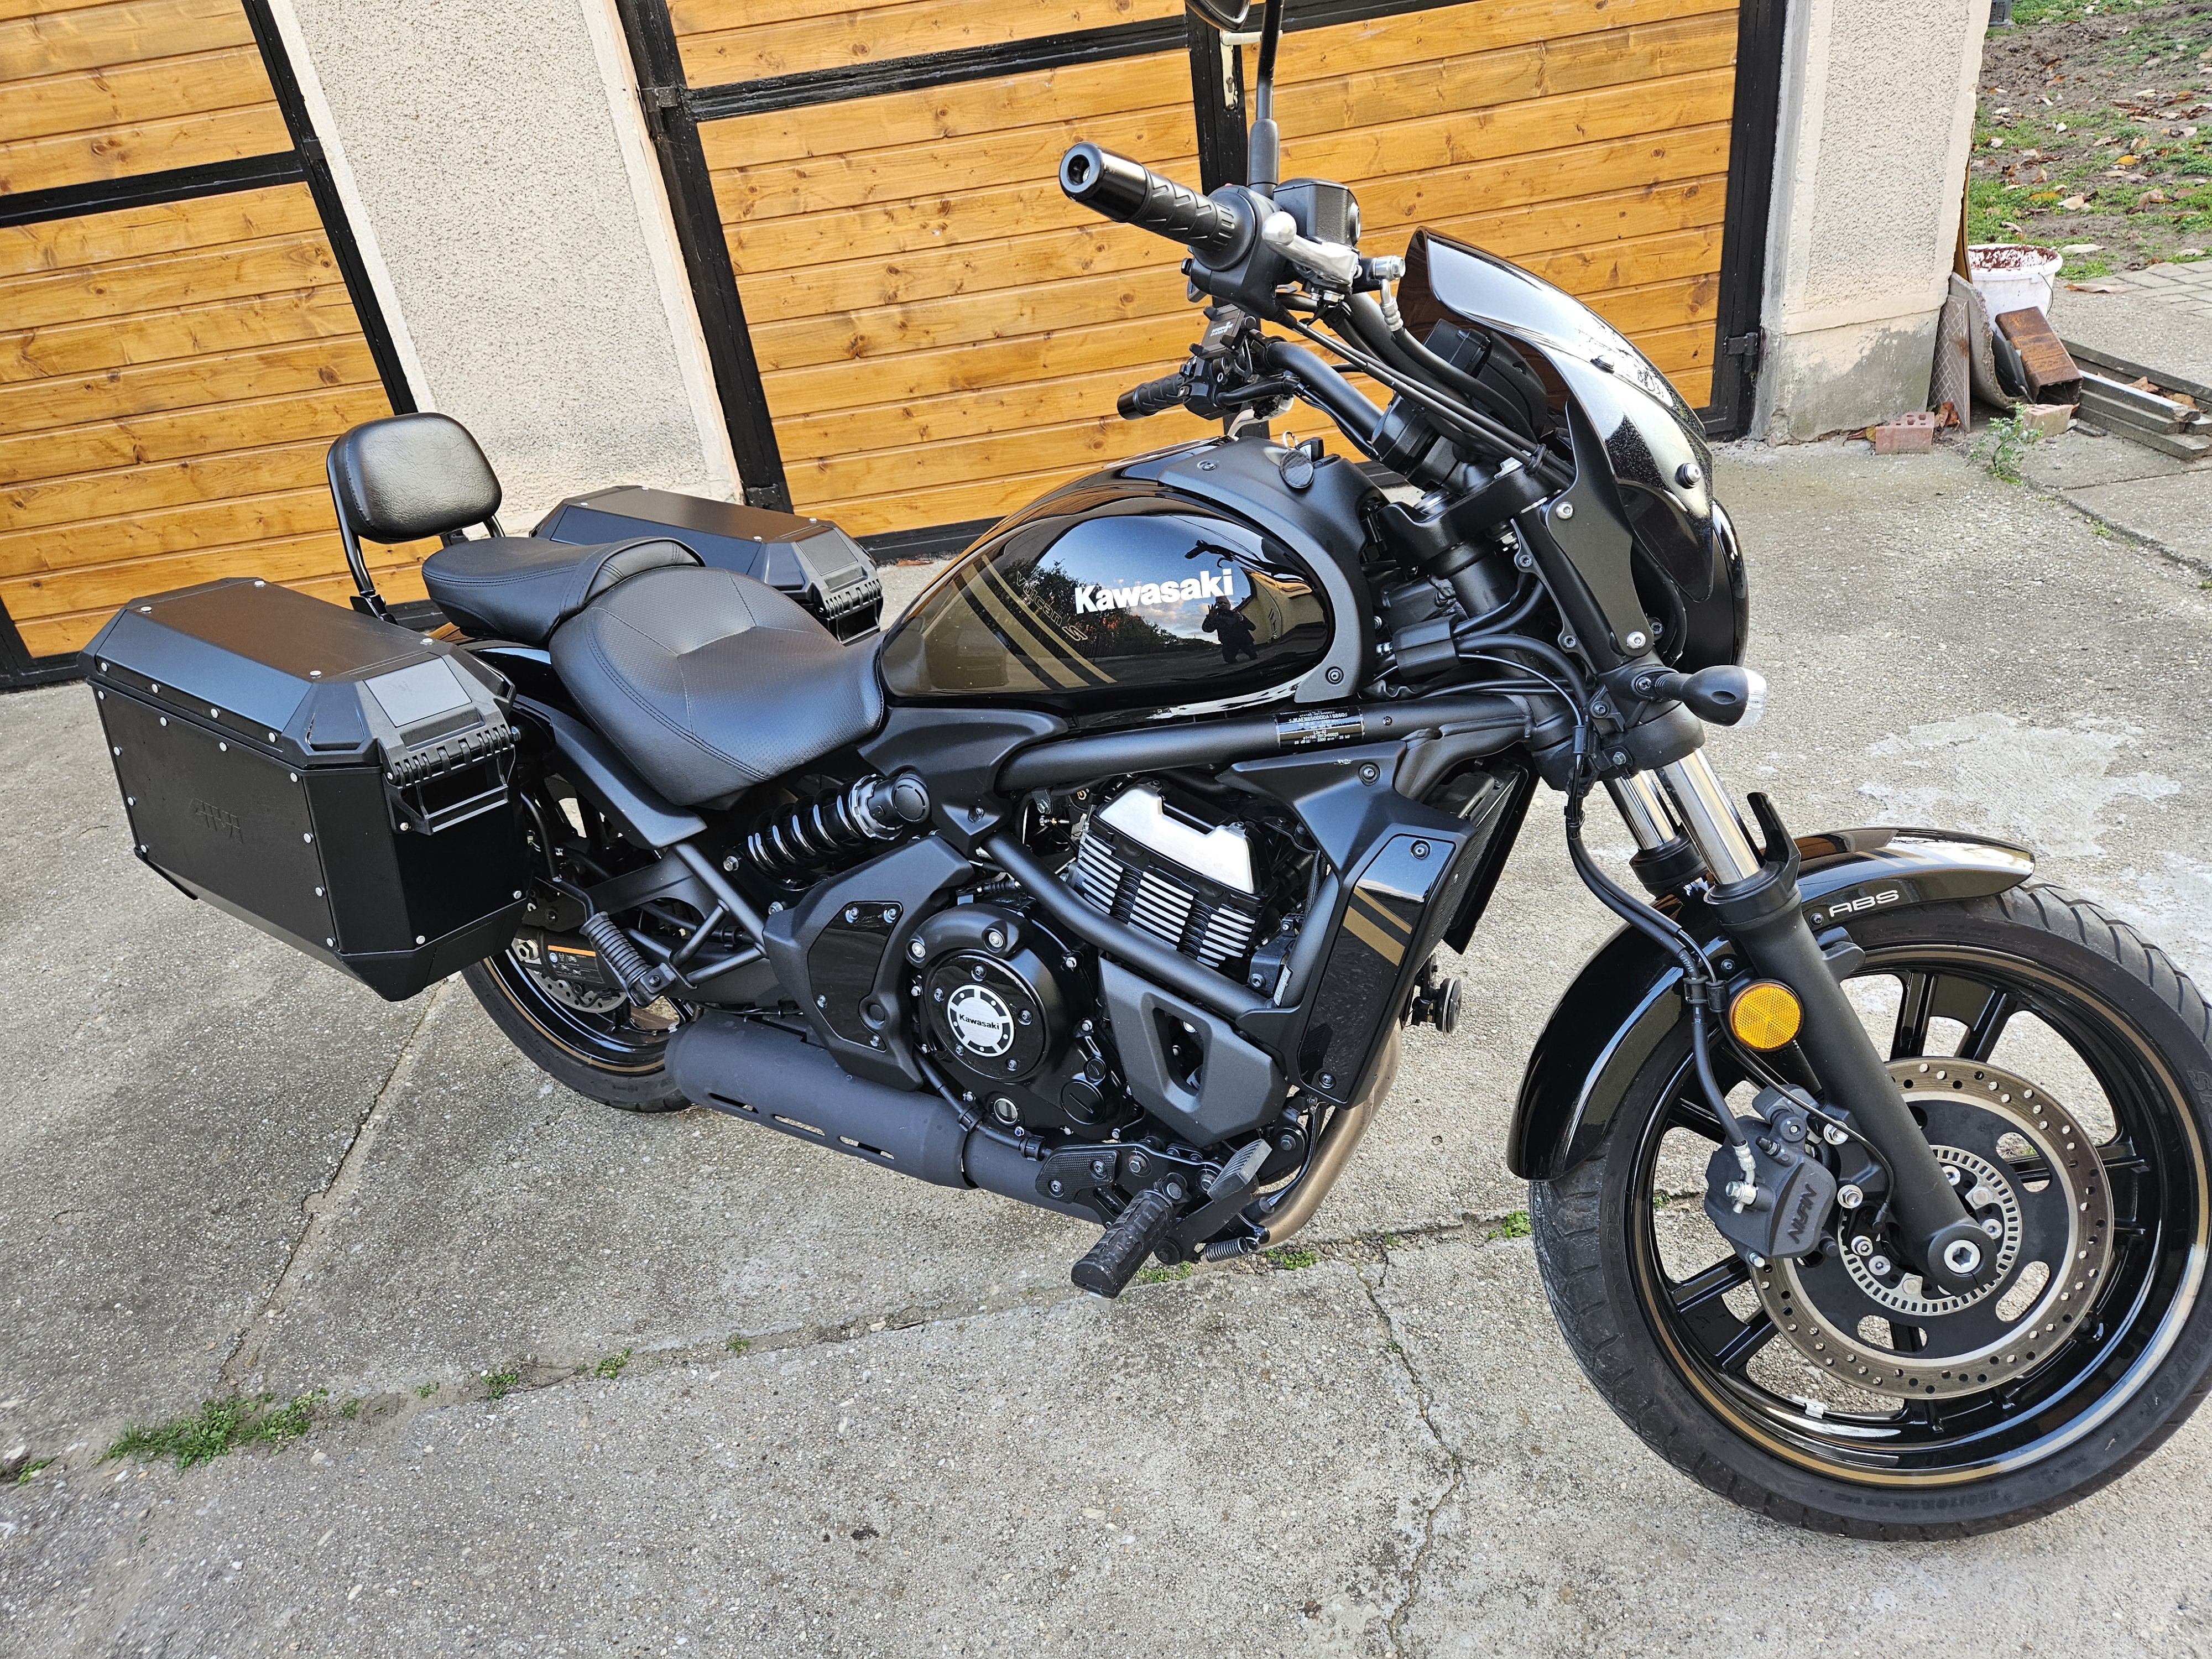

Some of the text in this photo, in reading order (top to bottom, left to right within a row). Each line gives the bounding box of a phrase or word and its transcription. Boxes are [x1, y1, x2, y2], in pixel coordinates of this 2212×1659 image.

[1016, 570, 1088, 641] Vulcan S
[1075, 568, 1234, 614] Kawasaki
[1829, 890, 1899, 917] ABS
[959, 1013, 1000, 1030] Kawasaki
[1606, 1200, 1643, 1341] DUNLOP
